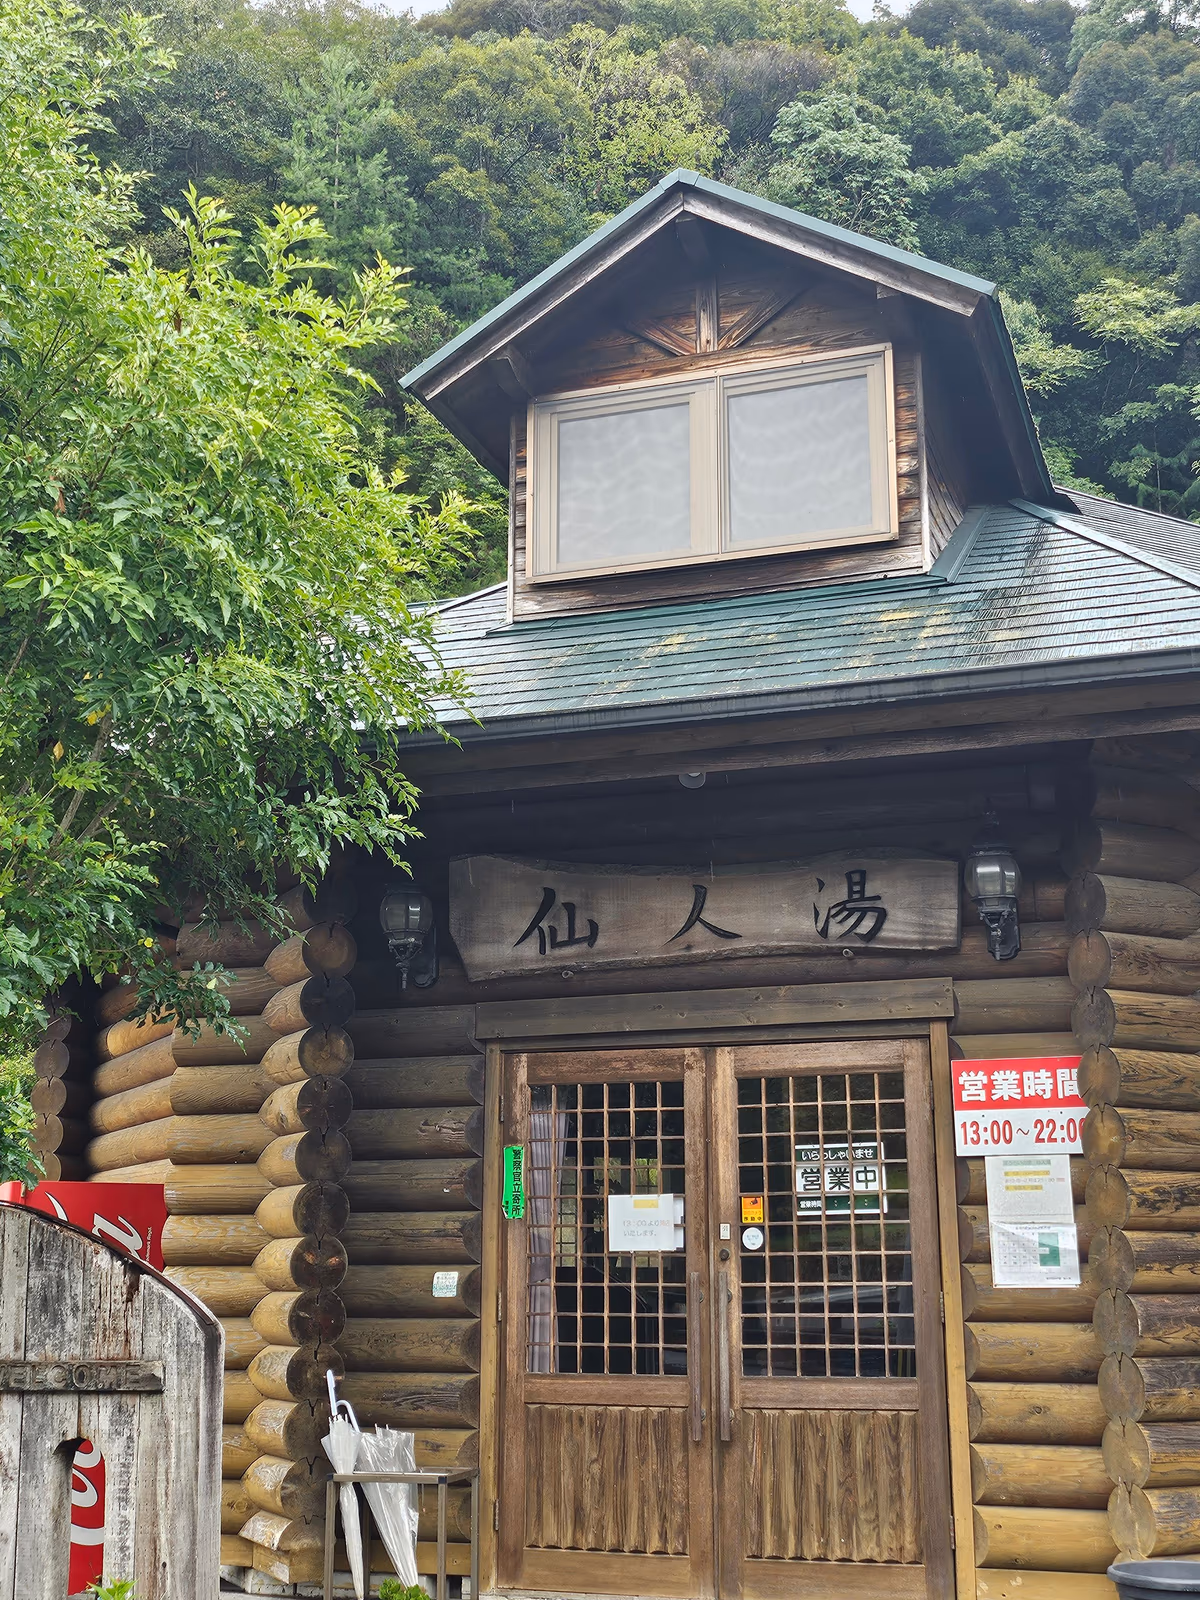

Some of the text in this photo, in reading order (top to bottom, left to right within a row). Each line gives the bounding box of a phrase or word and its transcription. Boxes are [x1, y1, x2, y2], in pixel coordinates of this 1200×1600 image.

[513, 869, 887, 954] 仙人湯
[958, 1068, 1081, 1102] 営業時間
[802, 1149, 873, 1161] いらっしゃいませ
[511, 1149, 522, 1216] 警察官立寄所
[801, 1166, 877, 1191] 営業中
